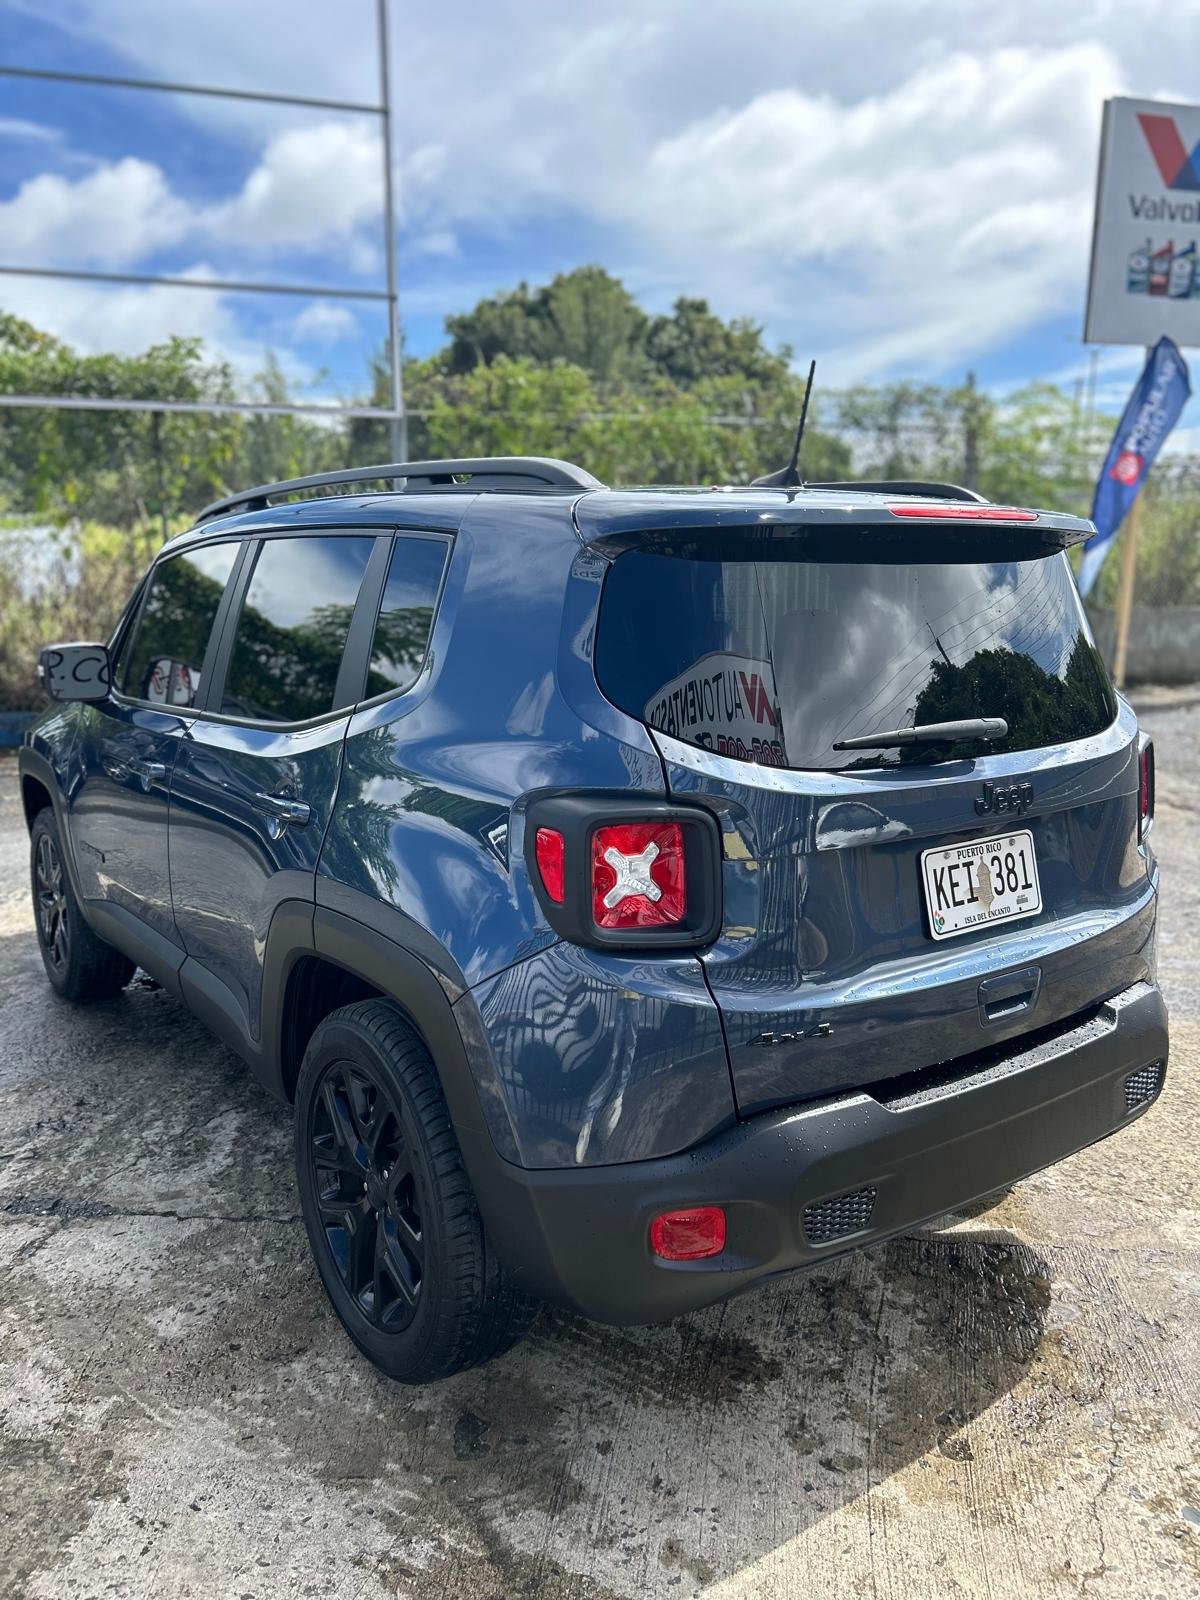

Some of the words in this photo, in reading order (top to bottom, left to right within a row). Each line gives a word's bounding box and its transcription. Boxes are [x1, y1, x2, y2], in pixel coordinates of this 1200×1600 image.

[974, 782, 1033, 816] Jeep
[956, 846, 984, 860] PUERTO
[985, 843, 1002, 854] RICO
[933, 860, 979, 911] KEI
[991, 850, 1033, 896] 381
[964, 914, 977, 925] ISLA
[977, 912, 988, 921] DEL
[988, 906, 1011, 919] ENCANTO
